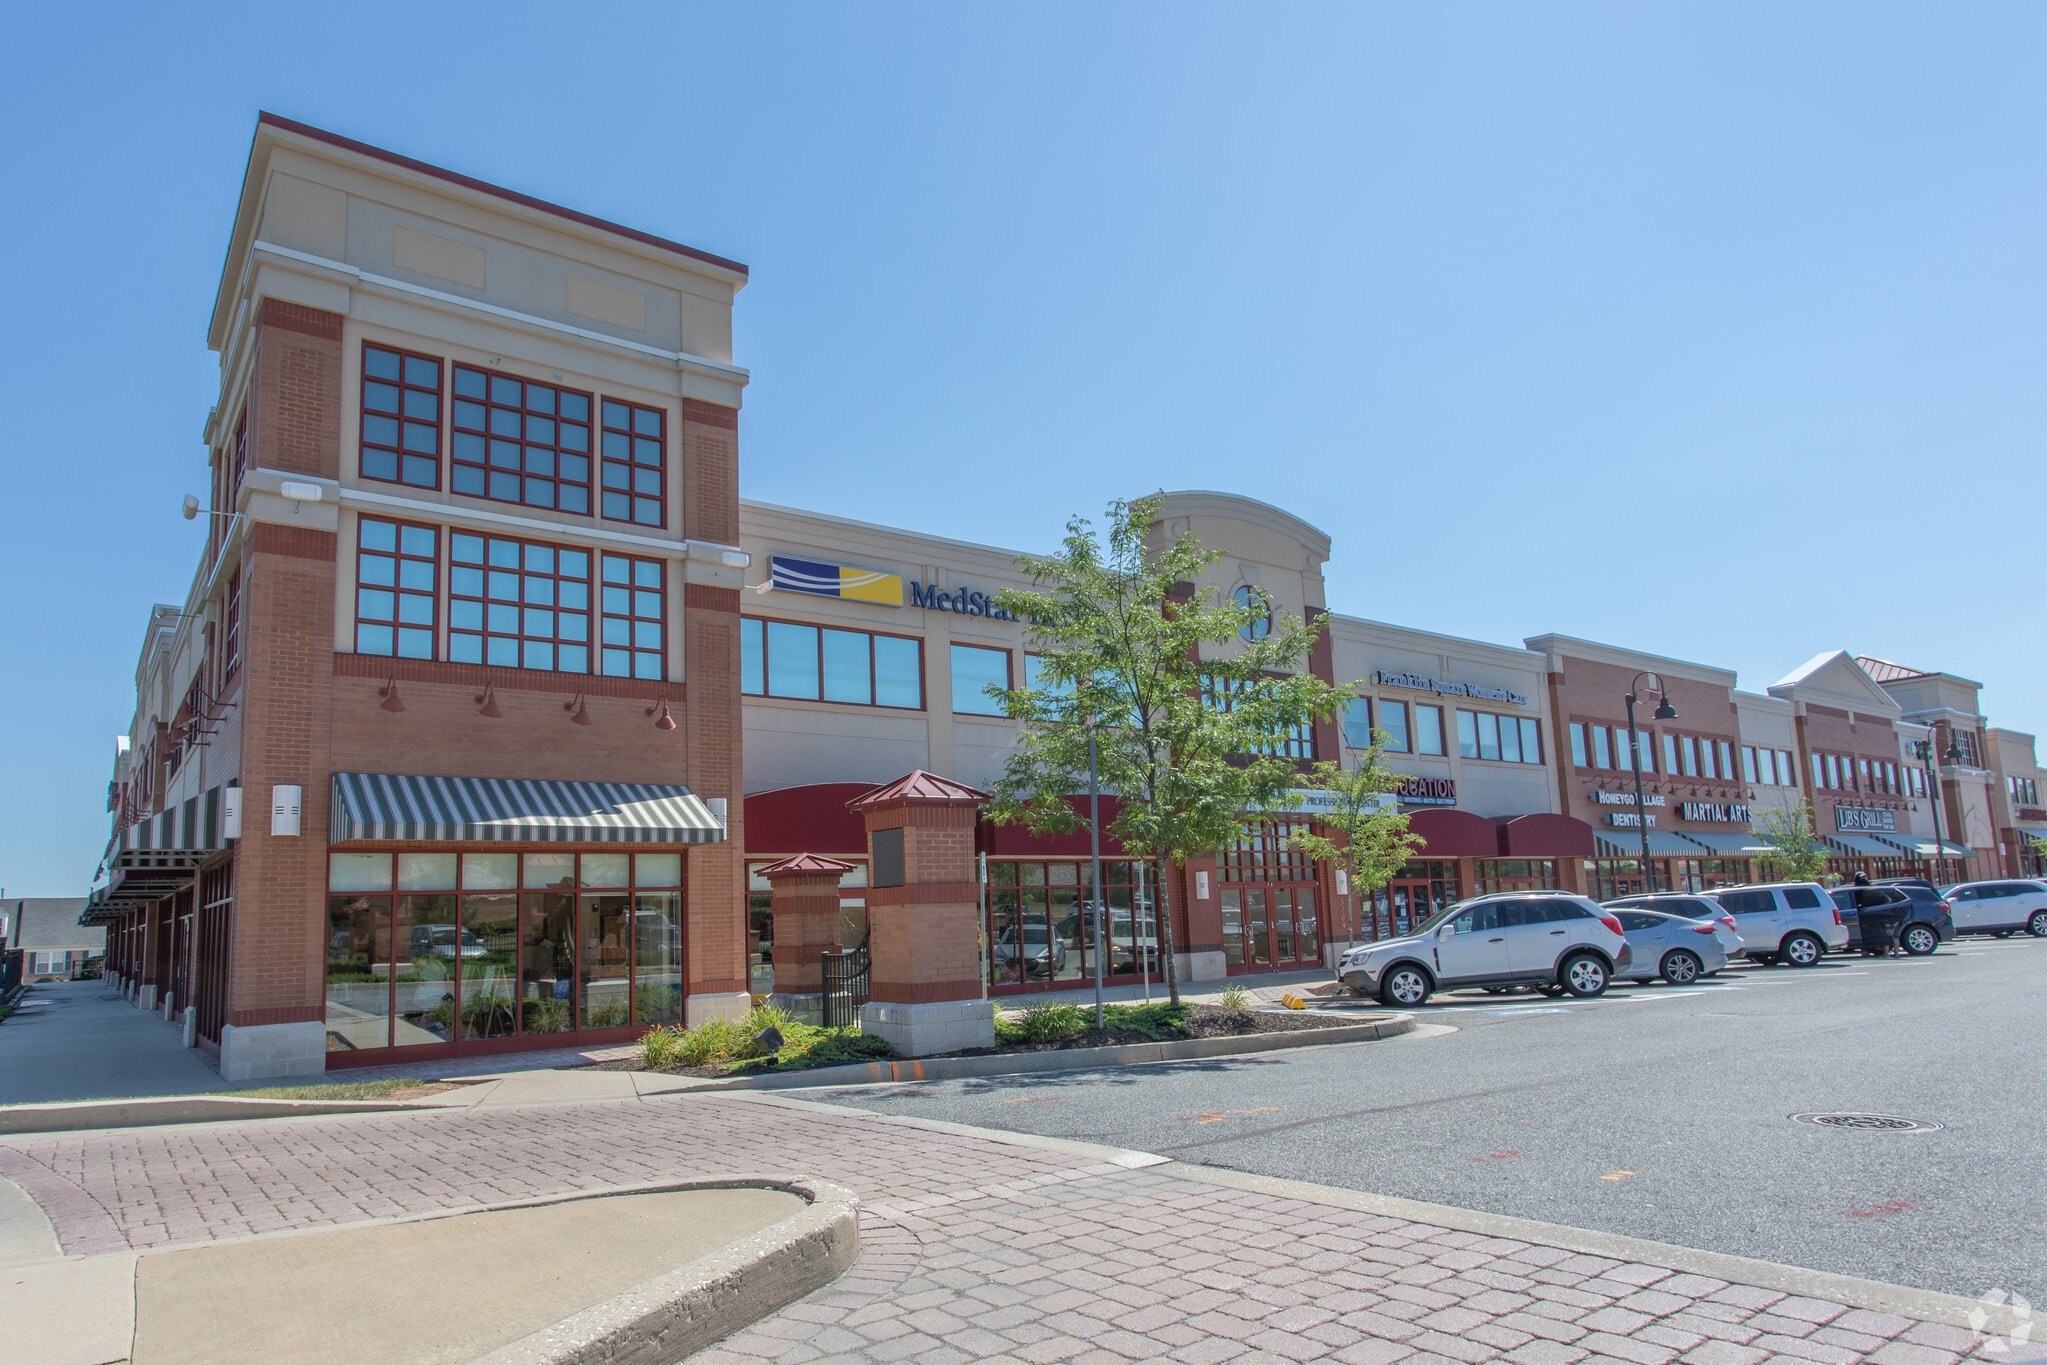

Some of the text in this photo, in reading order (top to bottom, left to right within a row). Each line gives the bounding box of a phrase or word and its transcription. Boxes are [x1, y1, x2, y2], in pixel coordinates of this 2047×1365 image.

[1377, 669, 1431, 691] Franklin
[1430, 678, 1467, 697] Square
[1598, 790, 1635, 805] HONEYGO
[1612, 813, 1656, 827] DENTISRY
[1683, 802, 1752, 822] MARTIAL ARTS
[1860, 810, 1882, 829] GRILL
